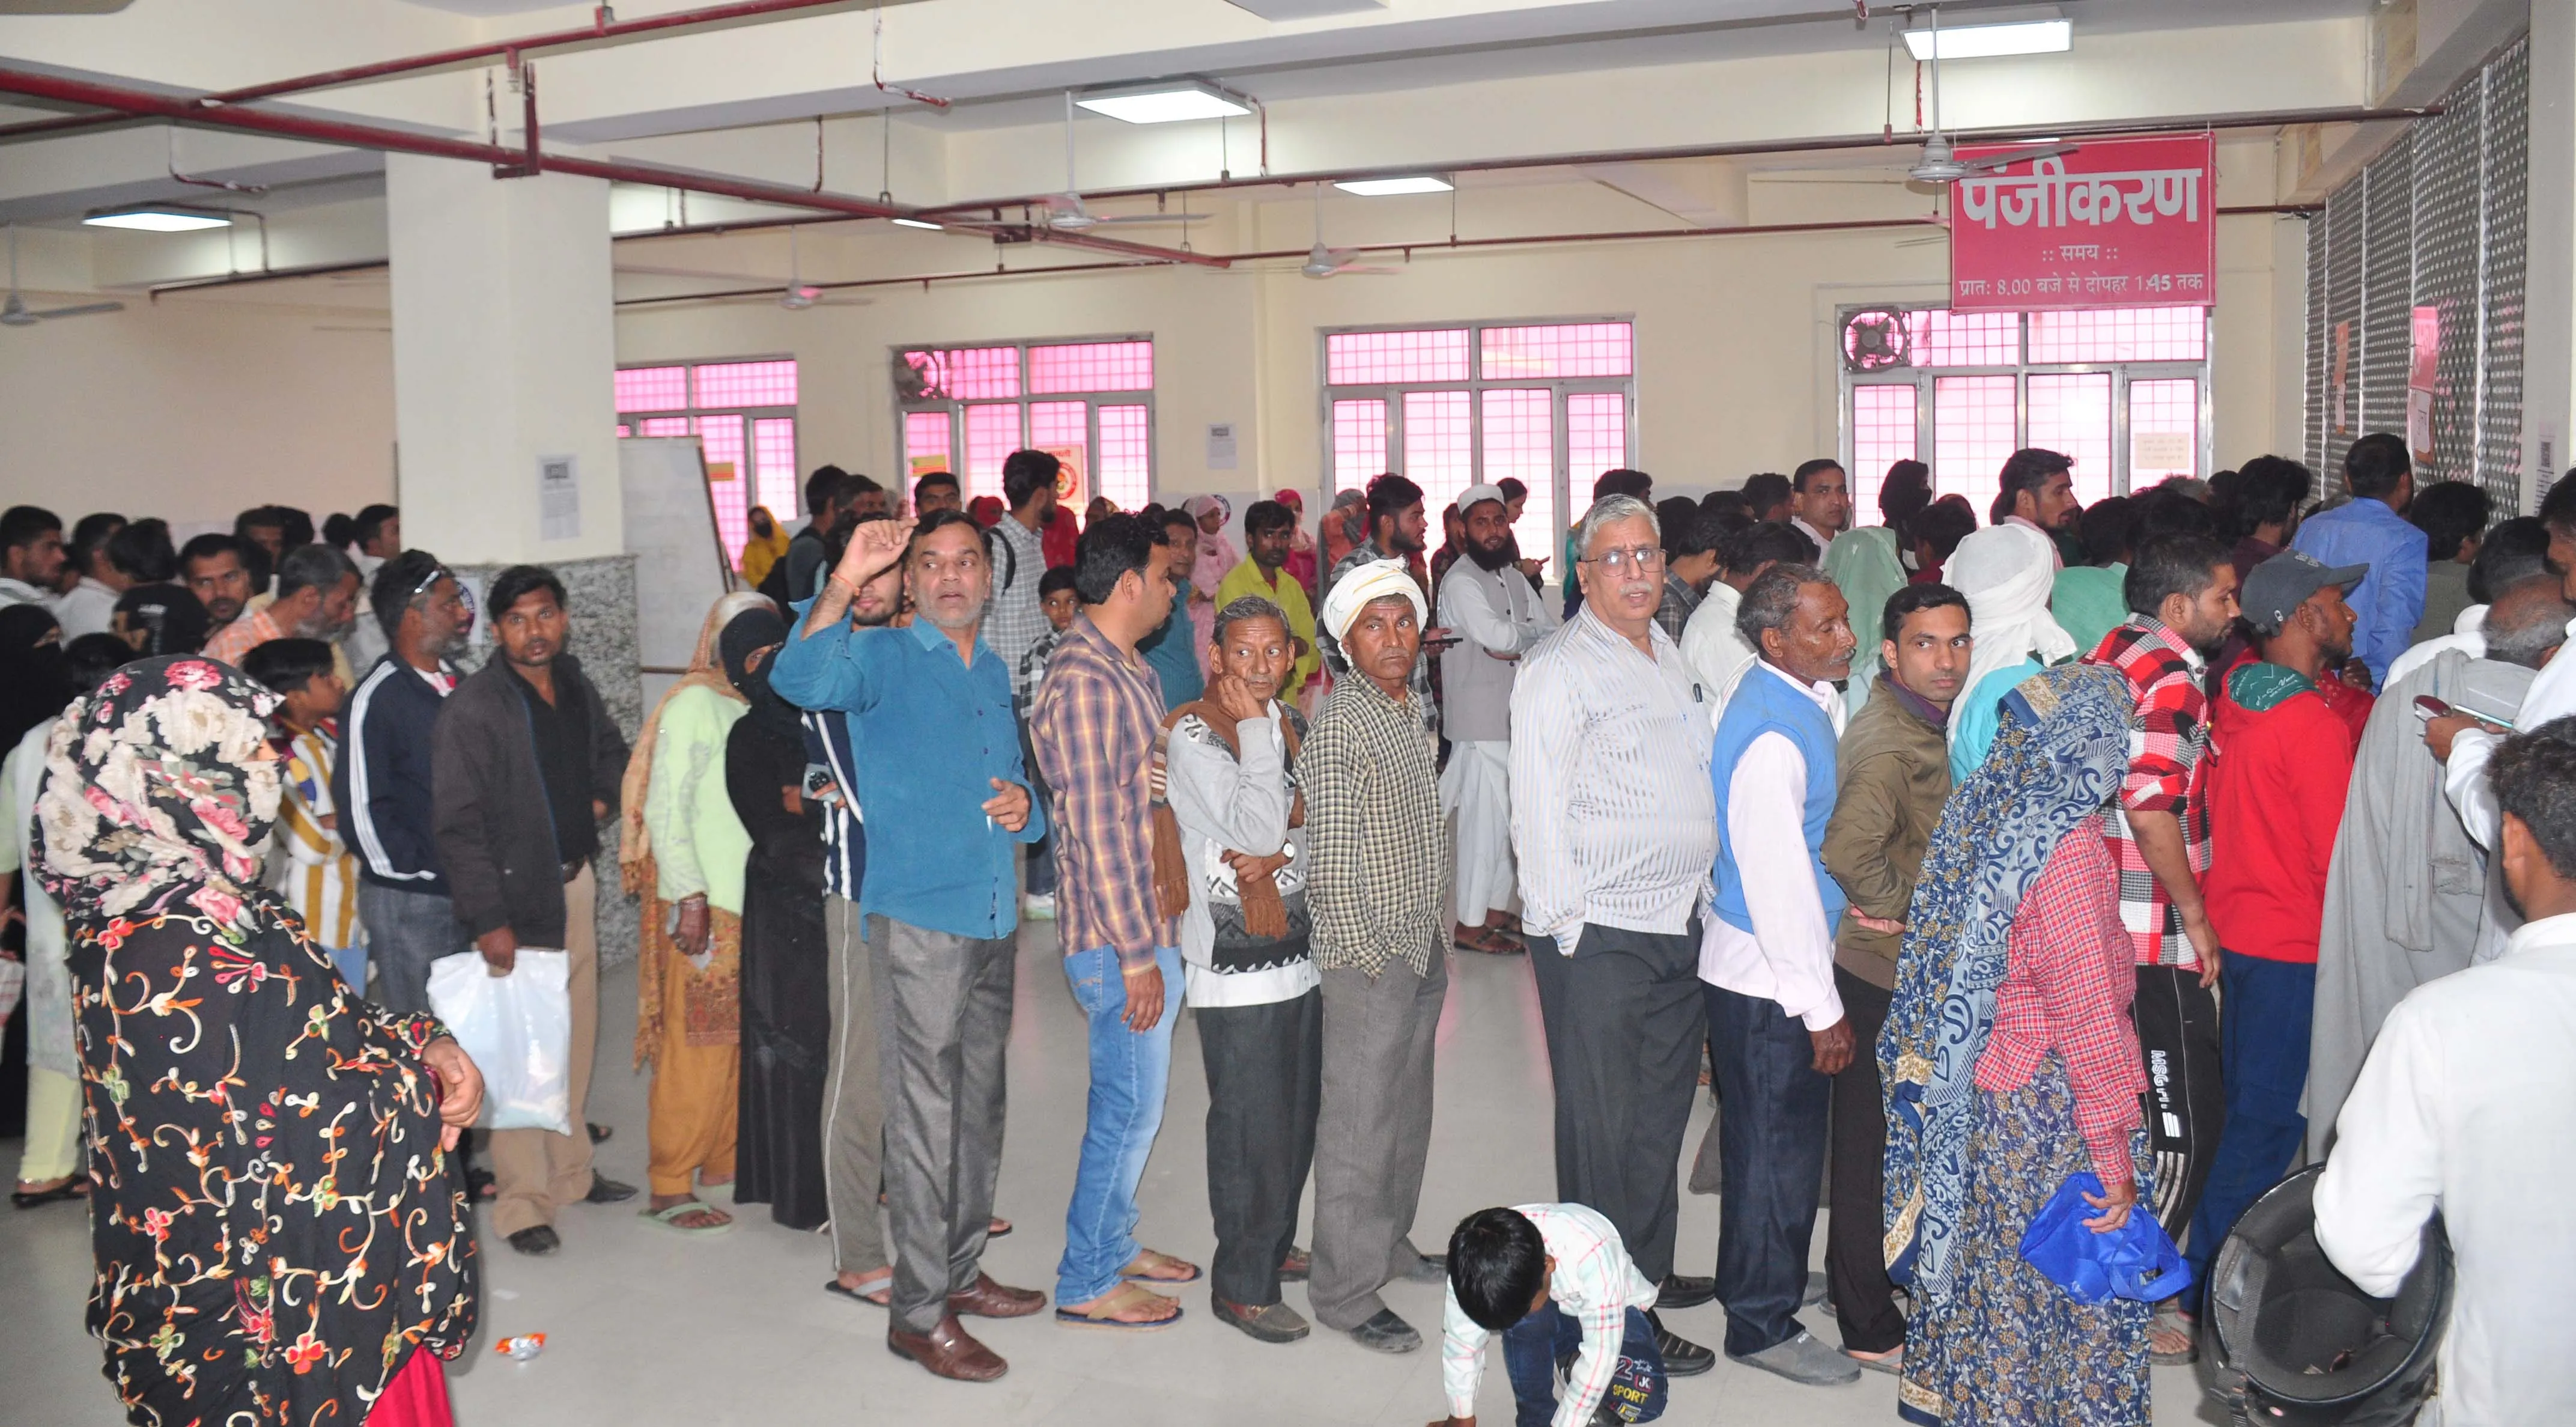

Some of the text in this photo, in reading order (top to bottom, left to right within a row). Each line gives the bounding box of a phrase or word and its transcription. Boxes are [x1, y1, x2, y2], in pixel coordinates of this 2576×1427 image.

[1959, 154, 2202, 230] पंजीकरण
[2059, 245, 2100, 262] समय
[1997, 278, 2031, 296] 8.00
[2036, 272, 2062, 293] बजे
[2067, 272, 2080, 293] से
[2085, 271, 2128, 295] दोपहर
[2175, 273, 2204, 290] तक
[1613, 1384, 1648, 1404] SPORT
